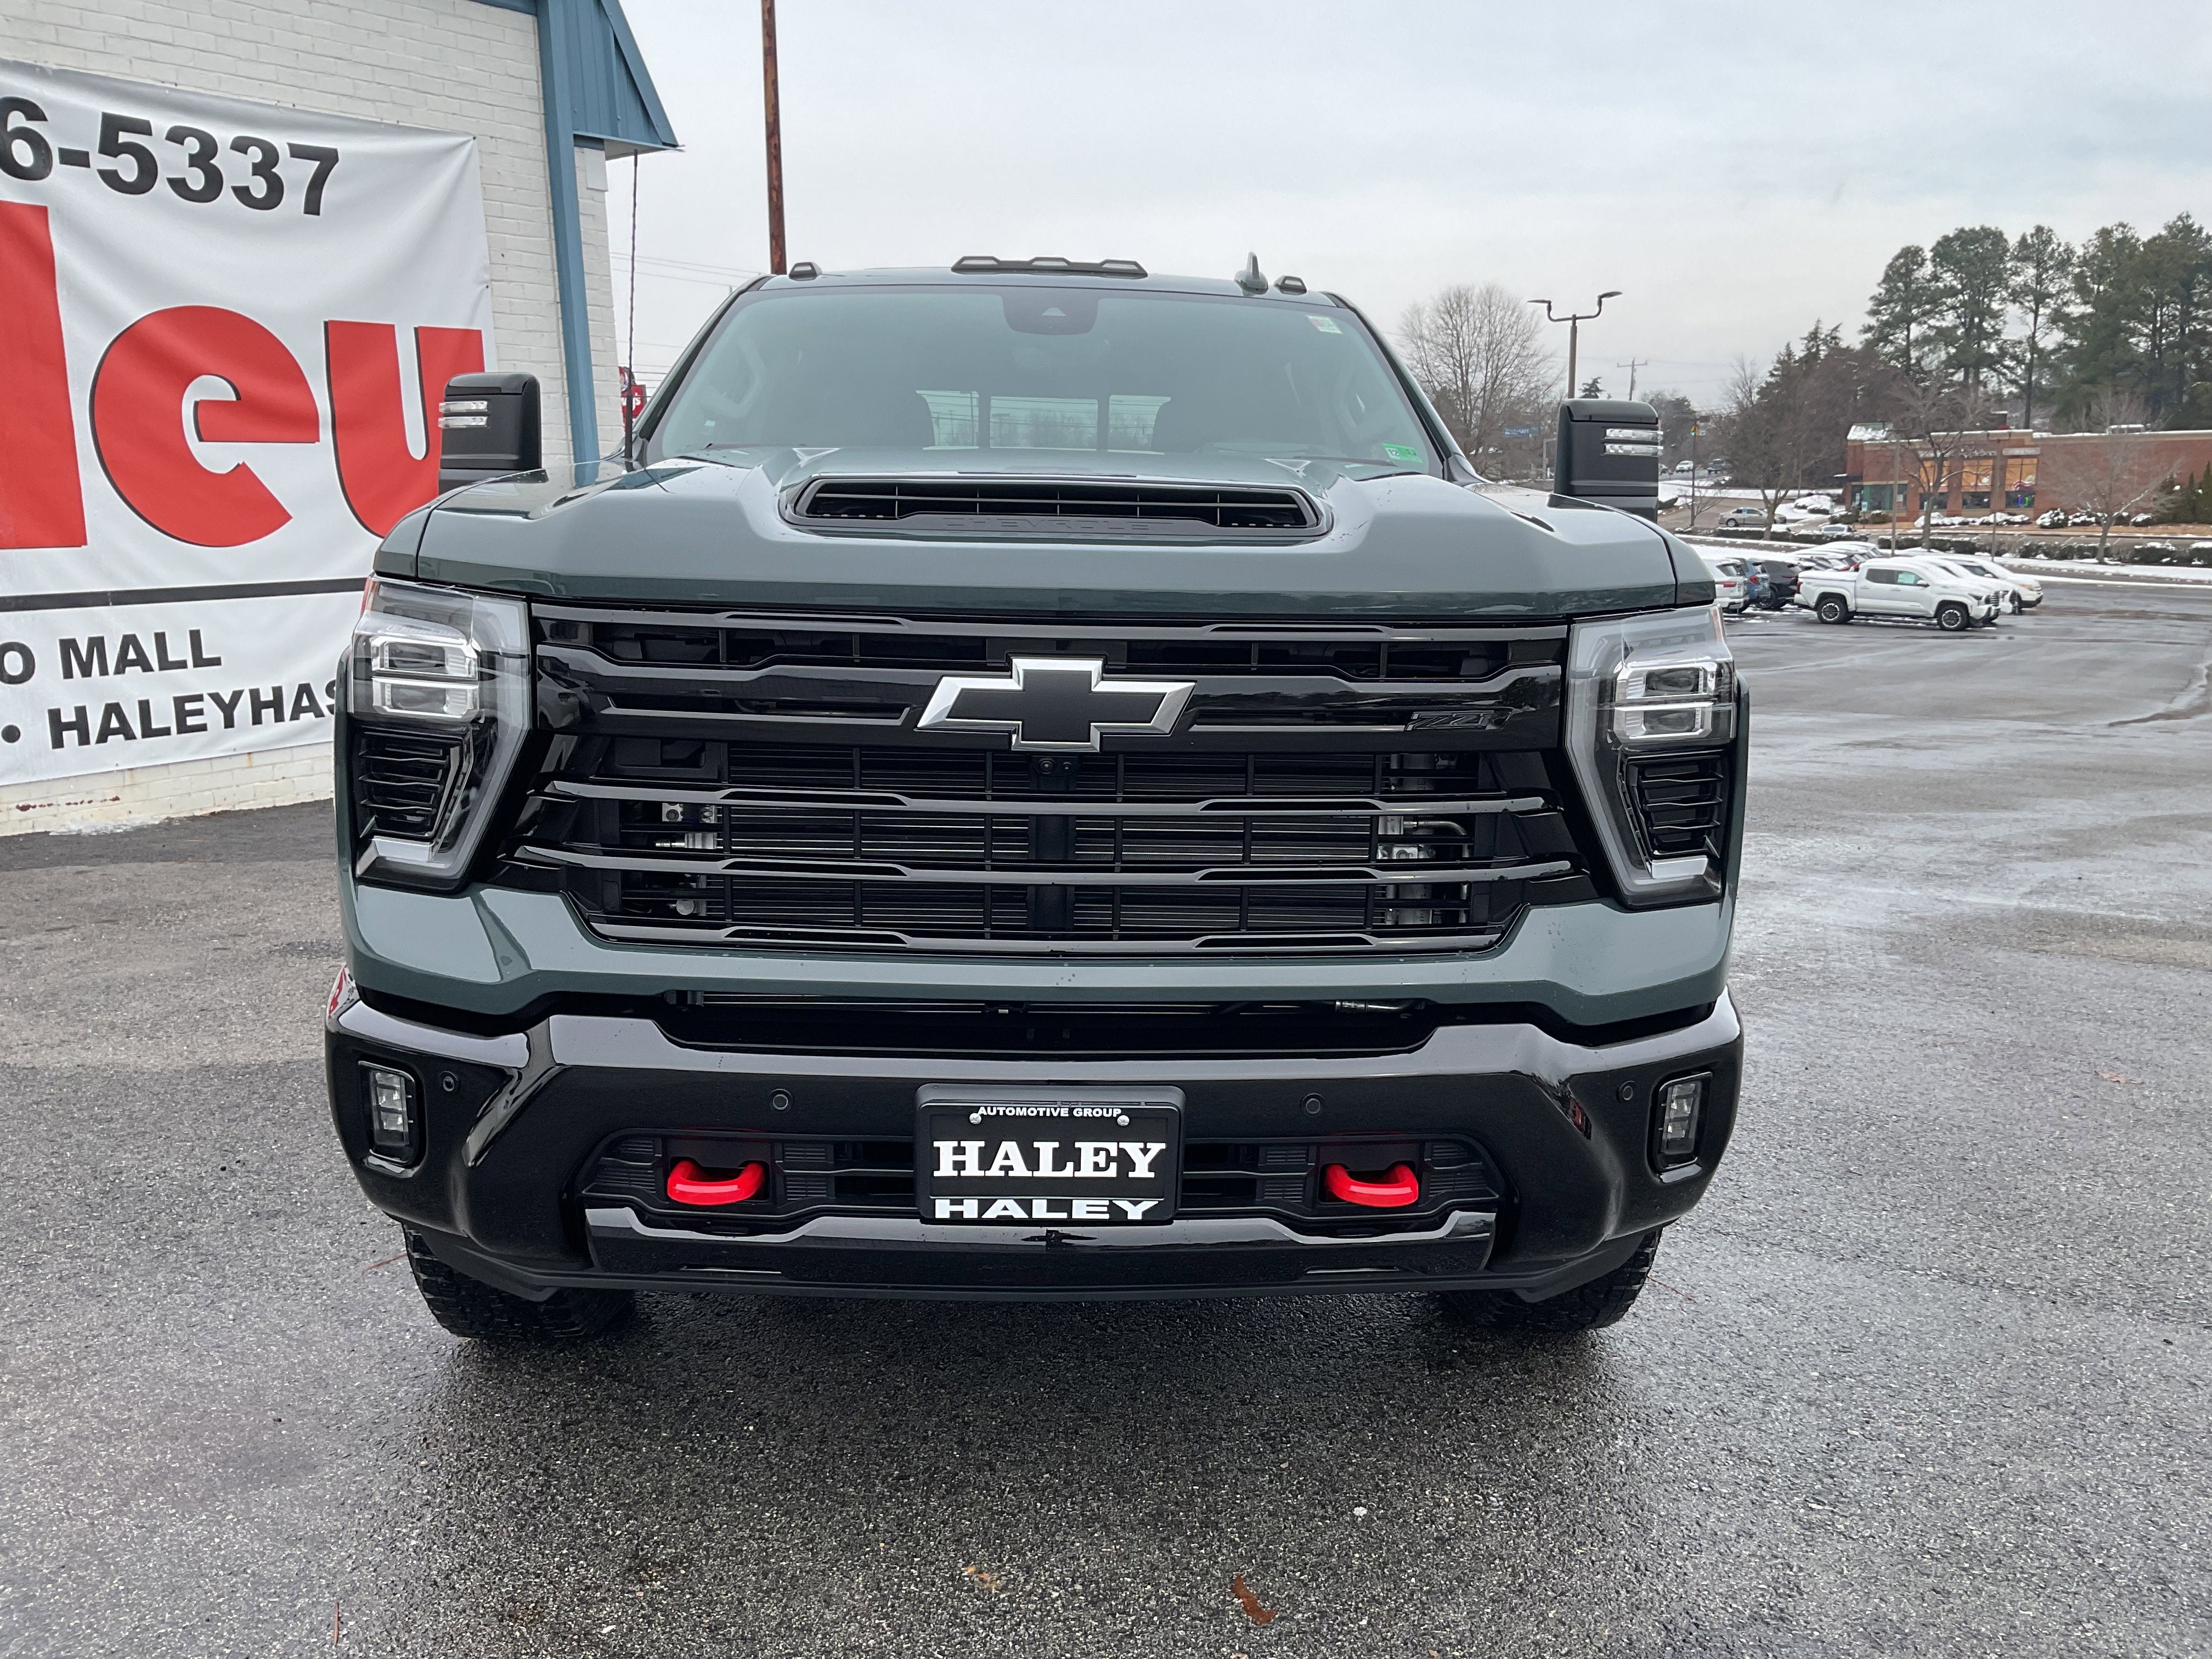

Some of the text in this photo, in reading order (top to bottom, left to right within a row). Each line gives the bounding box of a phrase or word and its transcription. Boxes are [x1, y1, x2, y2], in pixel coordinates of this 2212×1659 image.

[0, 96, 339, 216] 6-5337
[59, 629, 222, 679] MALL
[978, 1106, 1122, 1118] AUTOMOTIVE GROUP
[933, 1140, 1167, 1178] HALEY
[934, 1198, 1159, 1220] HALEY
